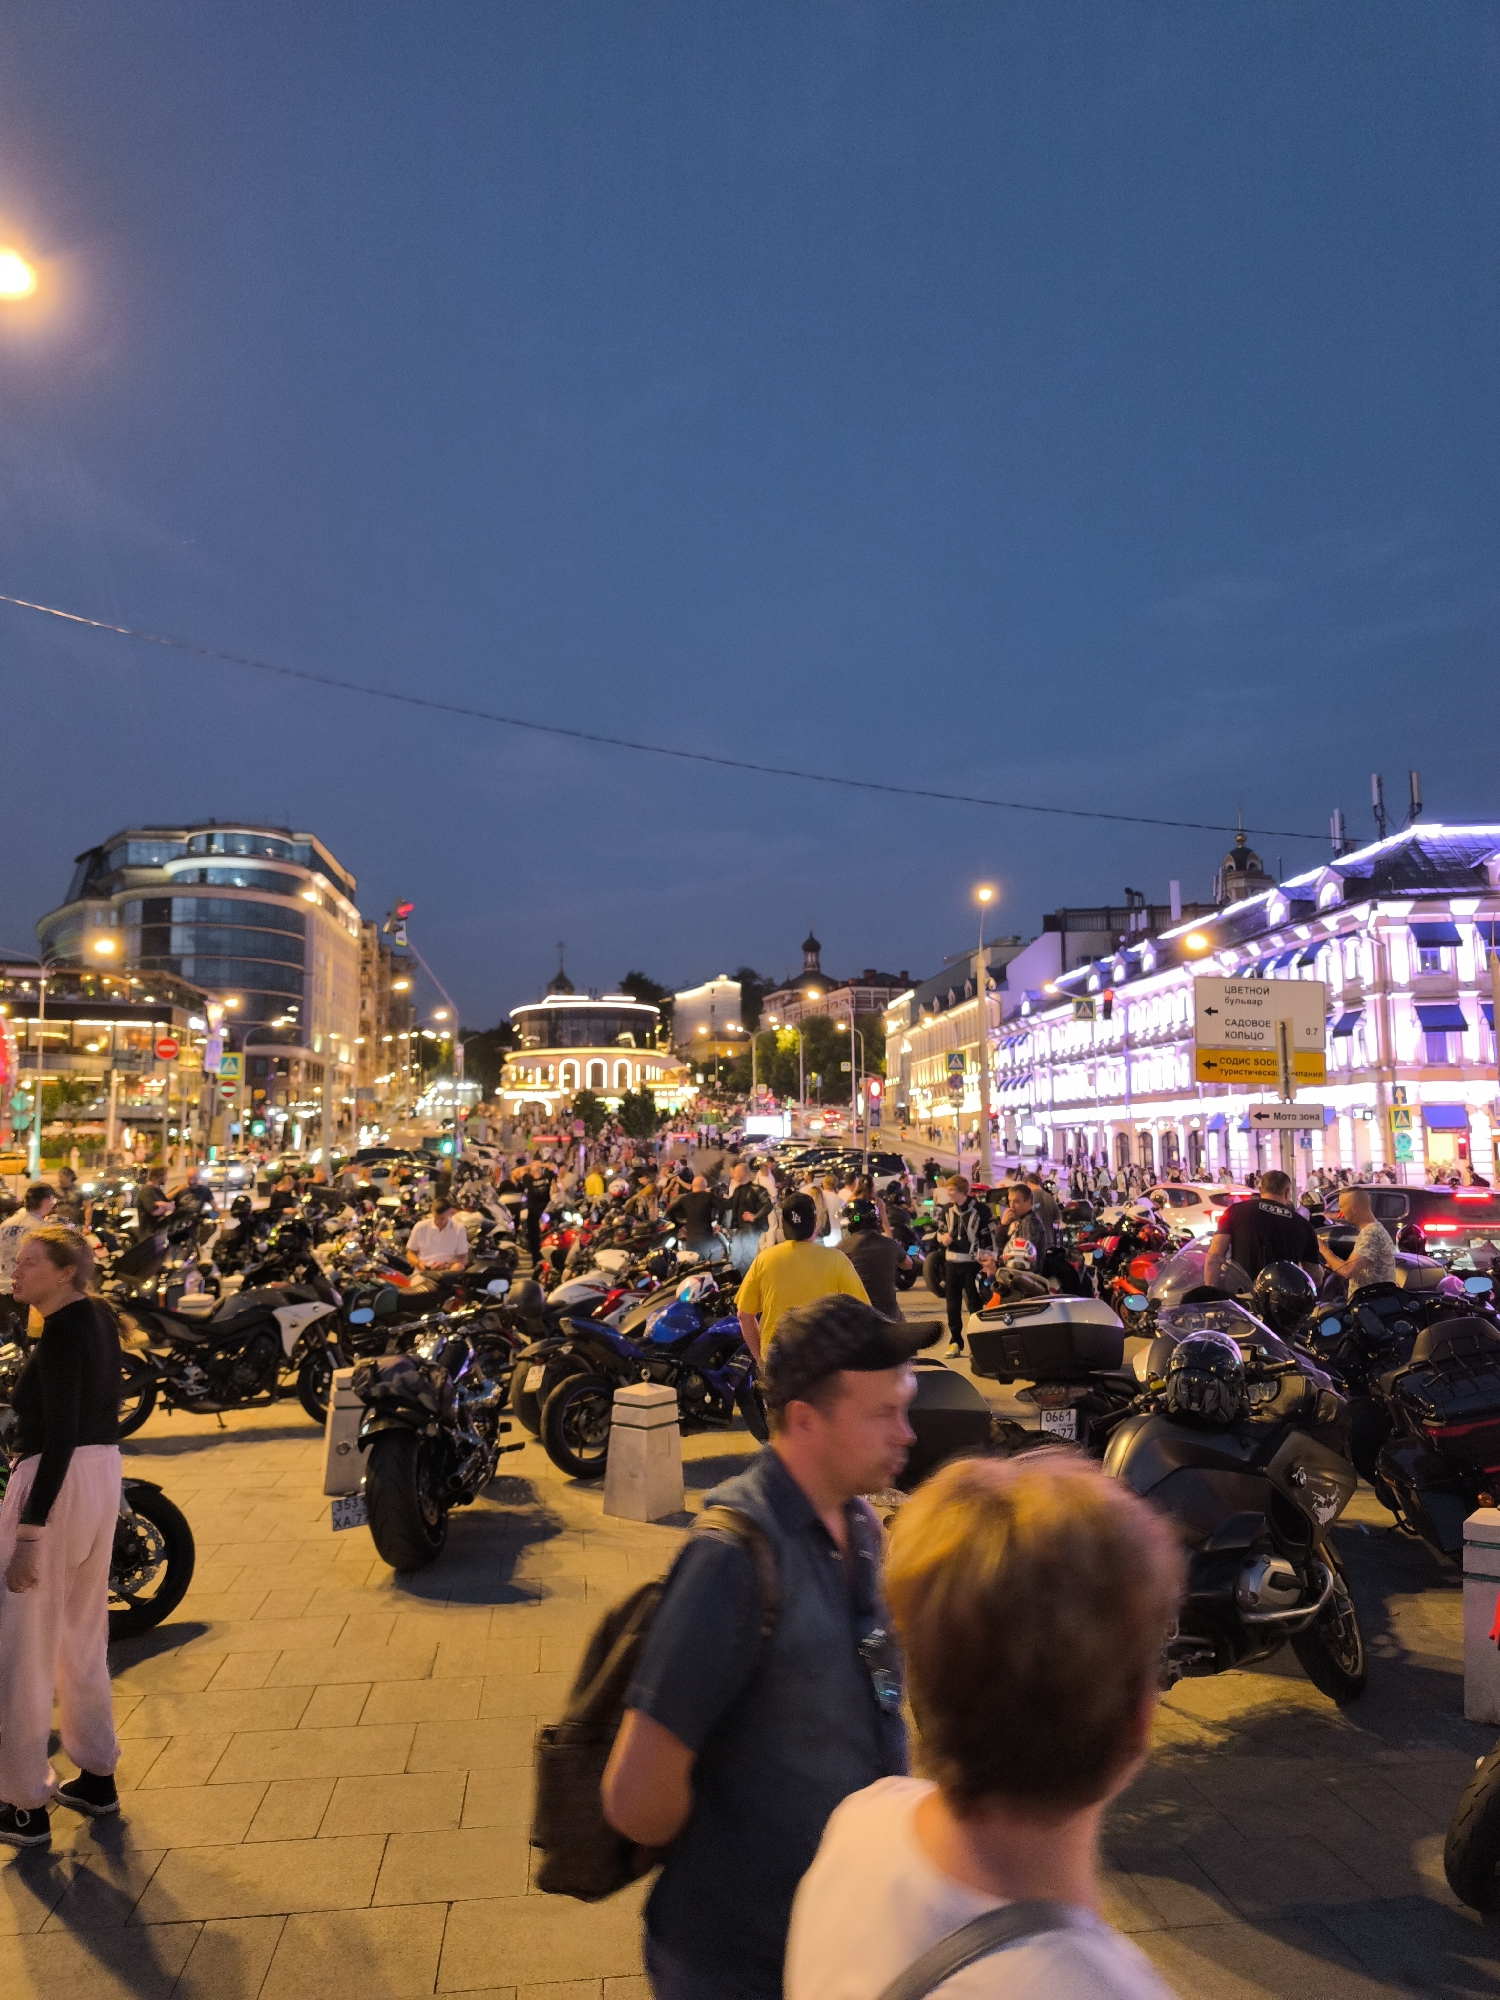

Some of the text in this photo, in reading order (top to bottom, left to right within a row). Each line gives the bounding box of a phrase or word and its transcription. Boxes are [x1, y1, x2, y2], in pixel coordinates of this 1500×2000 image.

[1224, 985, 1270, 995] ЦВЕТНОЙ
[1224, 996, 1263, 1006] бульвар
[1224, 1018, 1271, 1028] САДОВОЕ
[1224, 1030, 1264, 1041] КОЛЬЦО
[1305, 1027, 1318, 1036] 0.7
[1219, 1056, 1251, 1066] СОДИС
[1273, 1111, 1320, 1121] Мото зона
[791, 1210, 802, 1224] LA
[1045, 1410, 1072, 1423] 0661
